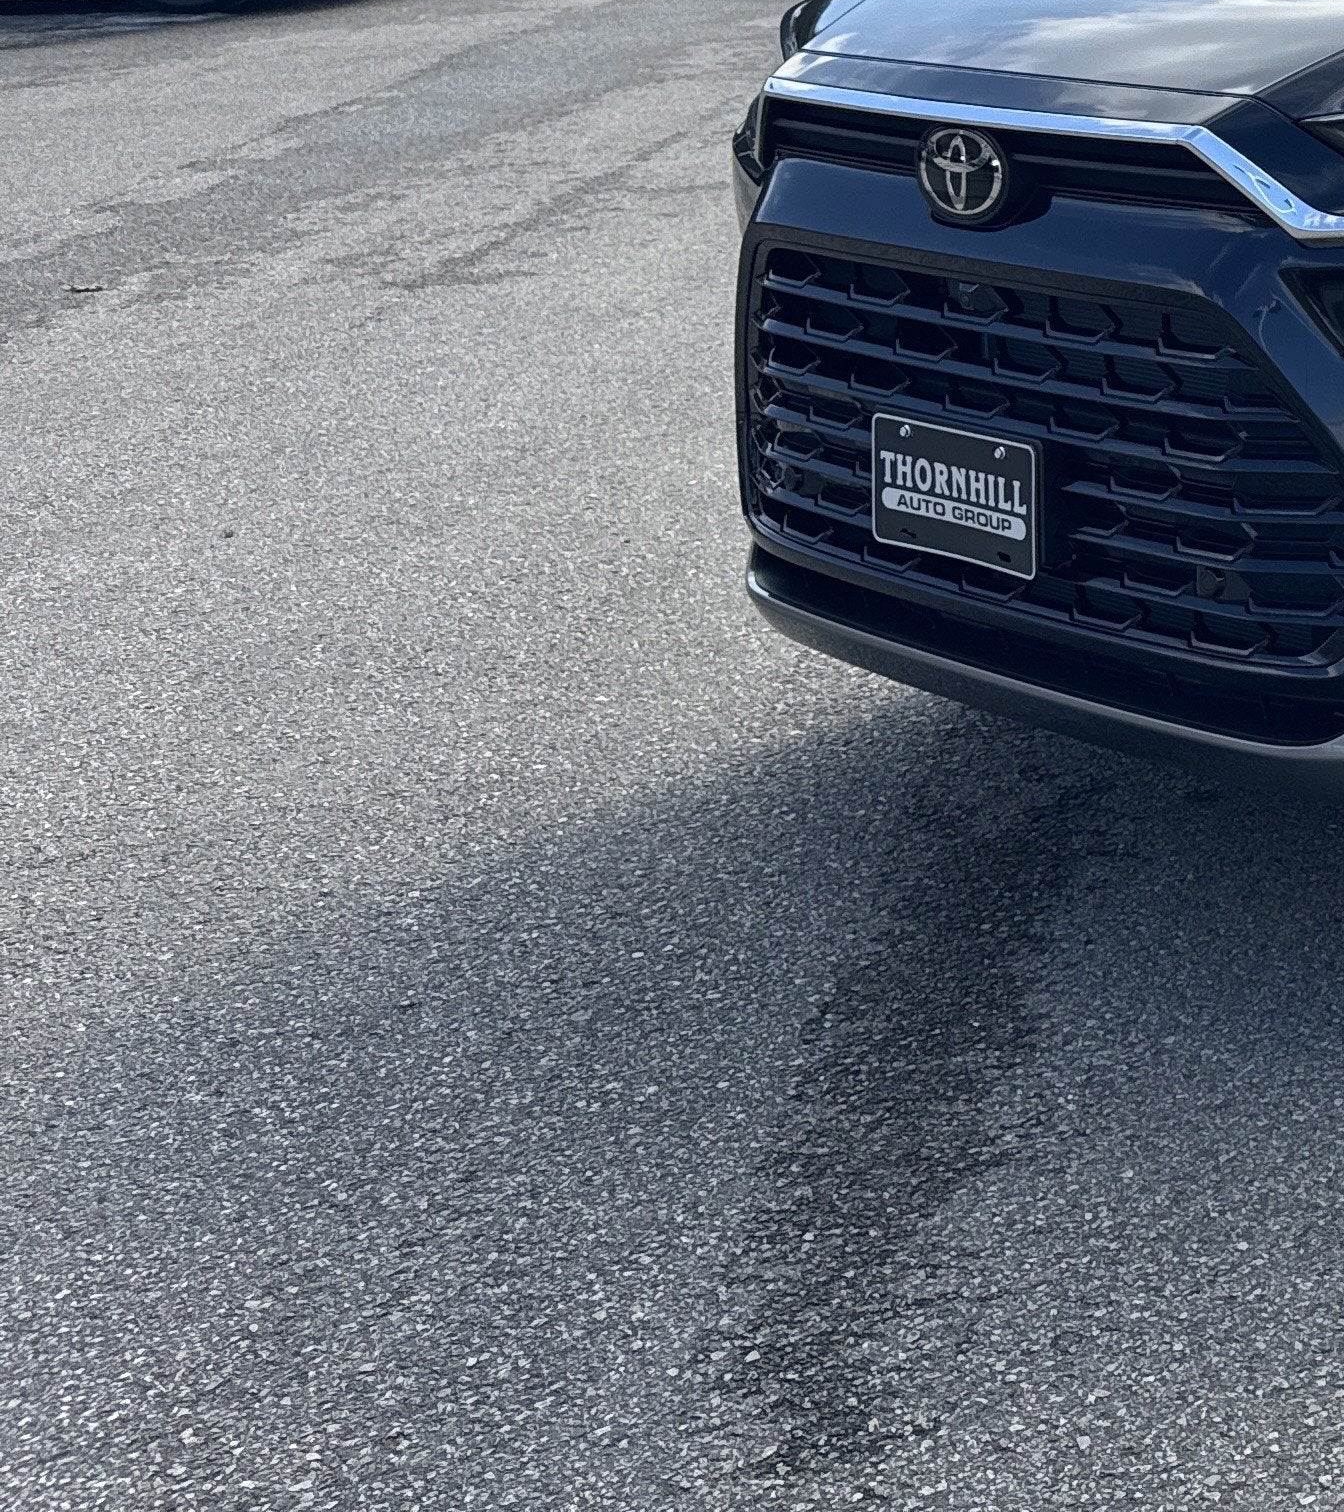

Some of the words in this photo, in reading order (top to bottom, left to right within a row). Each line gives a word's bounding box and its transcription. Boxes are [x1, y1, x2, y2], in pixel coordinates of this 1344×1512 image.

[880, 450, 1027, 516] THORNHILL
[896, 493, 946, 517] AUTO
[952, 506, 1012, 533] GROUP
